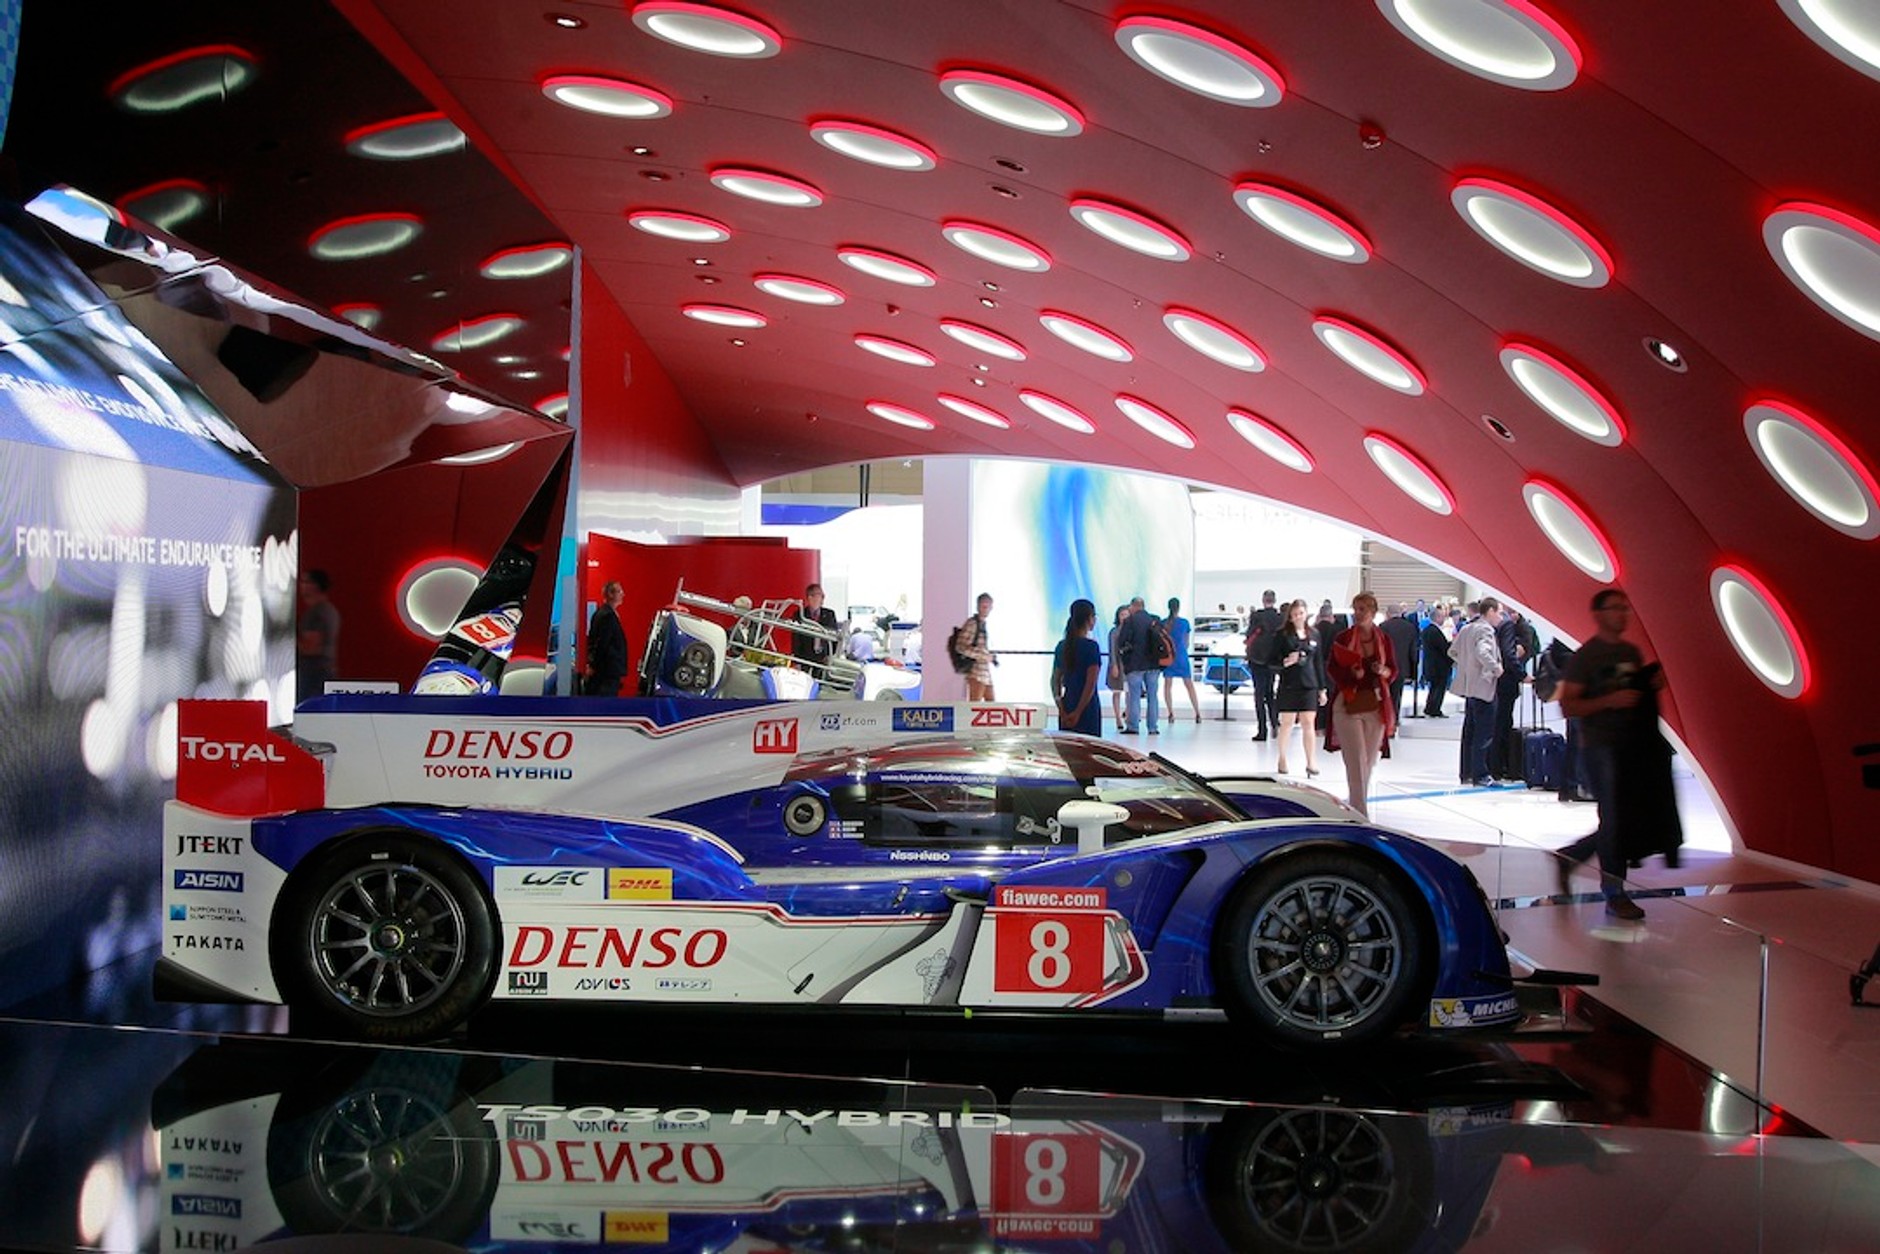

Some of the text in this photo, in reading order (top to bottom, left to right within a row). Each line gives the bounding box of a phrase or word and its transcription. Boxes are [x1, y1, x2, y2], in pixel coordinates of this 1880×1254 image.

[16, 526, 51, 557] FOR
[54, 530, 85, 560] THE
[88, 532, 156, 564] ULTIMATE
[842, 717, 877, 726] zf.com
[903, 709, 943, 723] KALDI
[971, 708, 1037, 727] ZENT
[755, 719, 797, 748] HY
[181, 737, 286, 762] TOTAL
[424, 729, 573, 760] DENSO
[424, 765, 573, 780] TOYOTA HYBRID
[176, 835, 244, 857] JTEKT
[180, 873, 240, 890] AISIN
[522, 870, 589, 886] WEC
[618, 879, 663, 890] DHL
[1001, 889, 1100, 907] fiawec.com
[173, 935, 245, 951] TAKATA
[507, 926, 729, 968] DENSO
[1027, 920, 1073, 989] 8
[728, 1109, 1013, 1130] HYBRID
